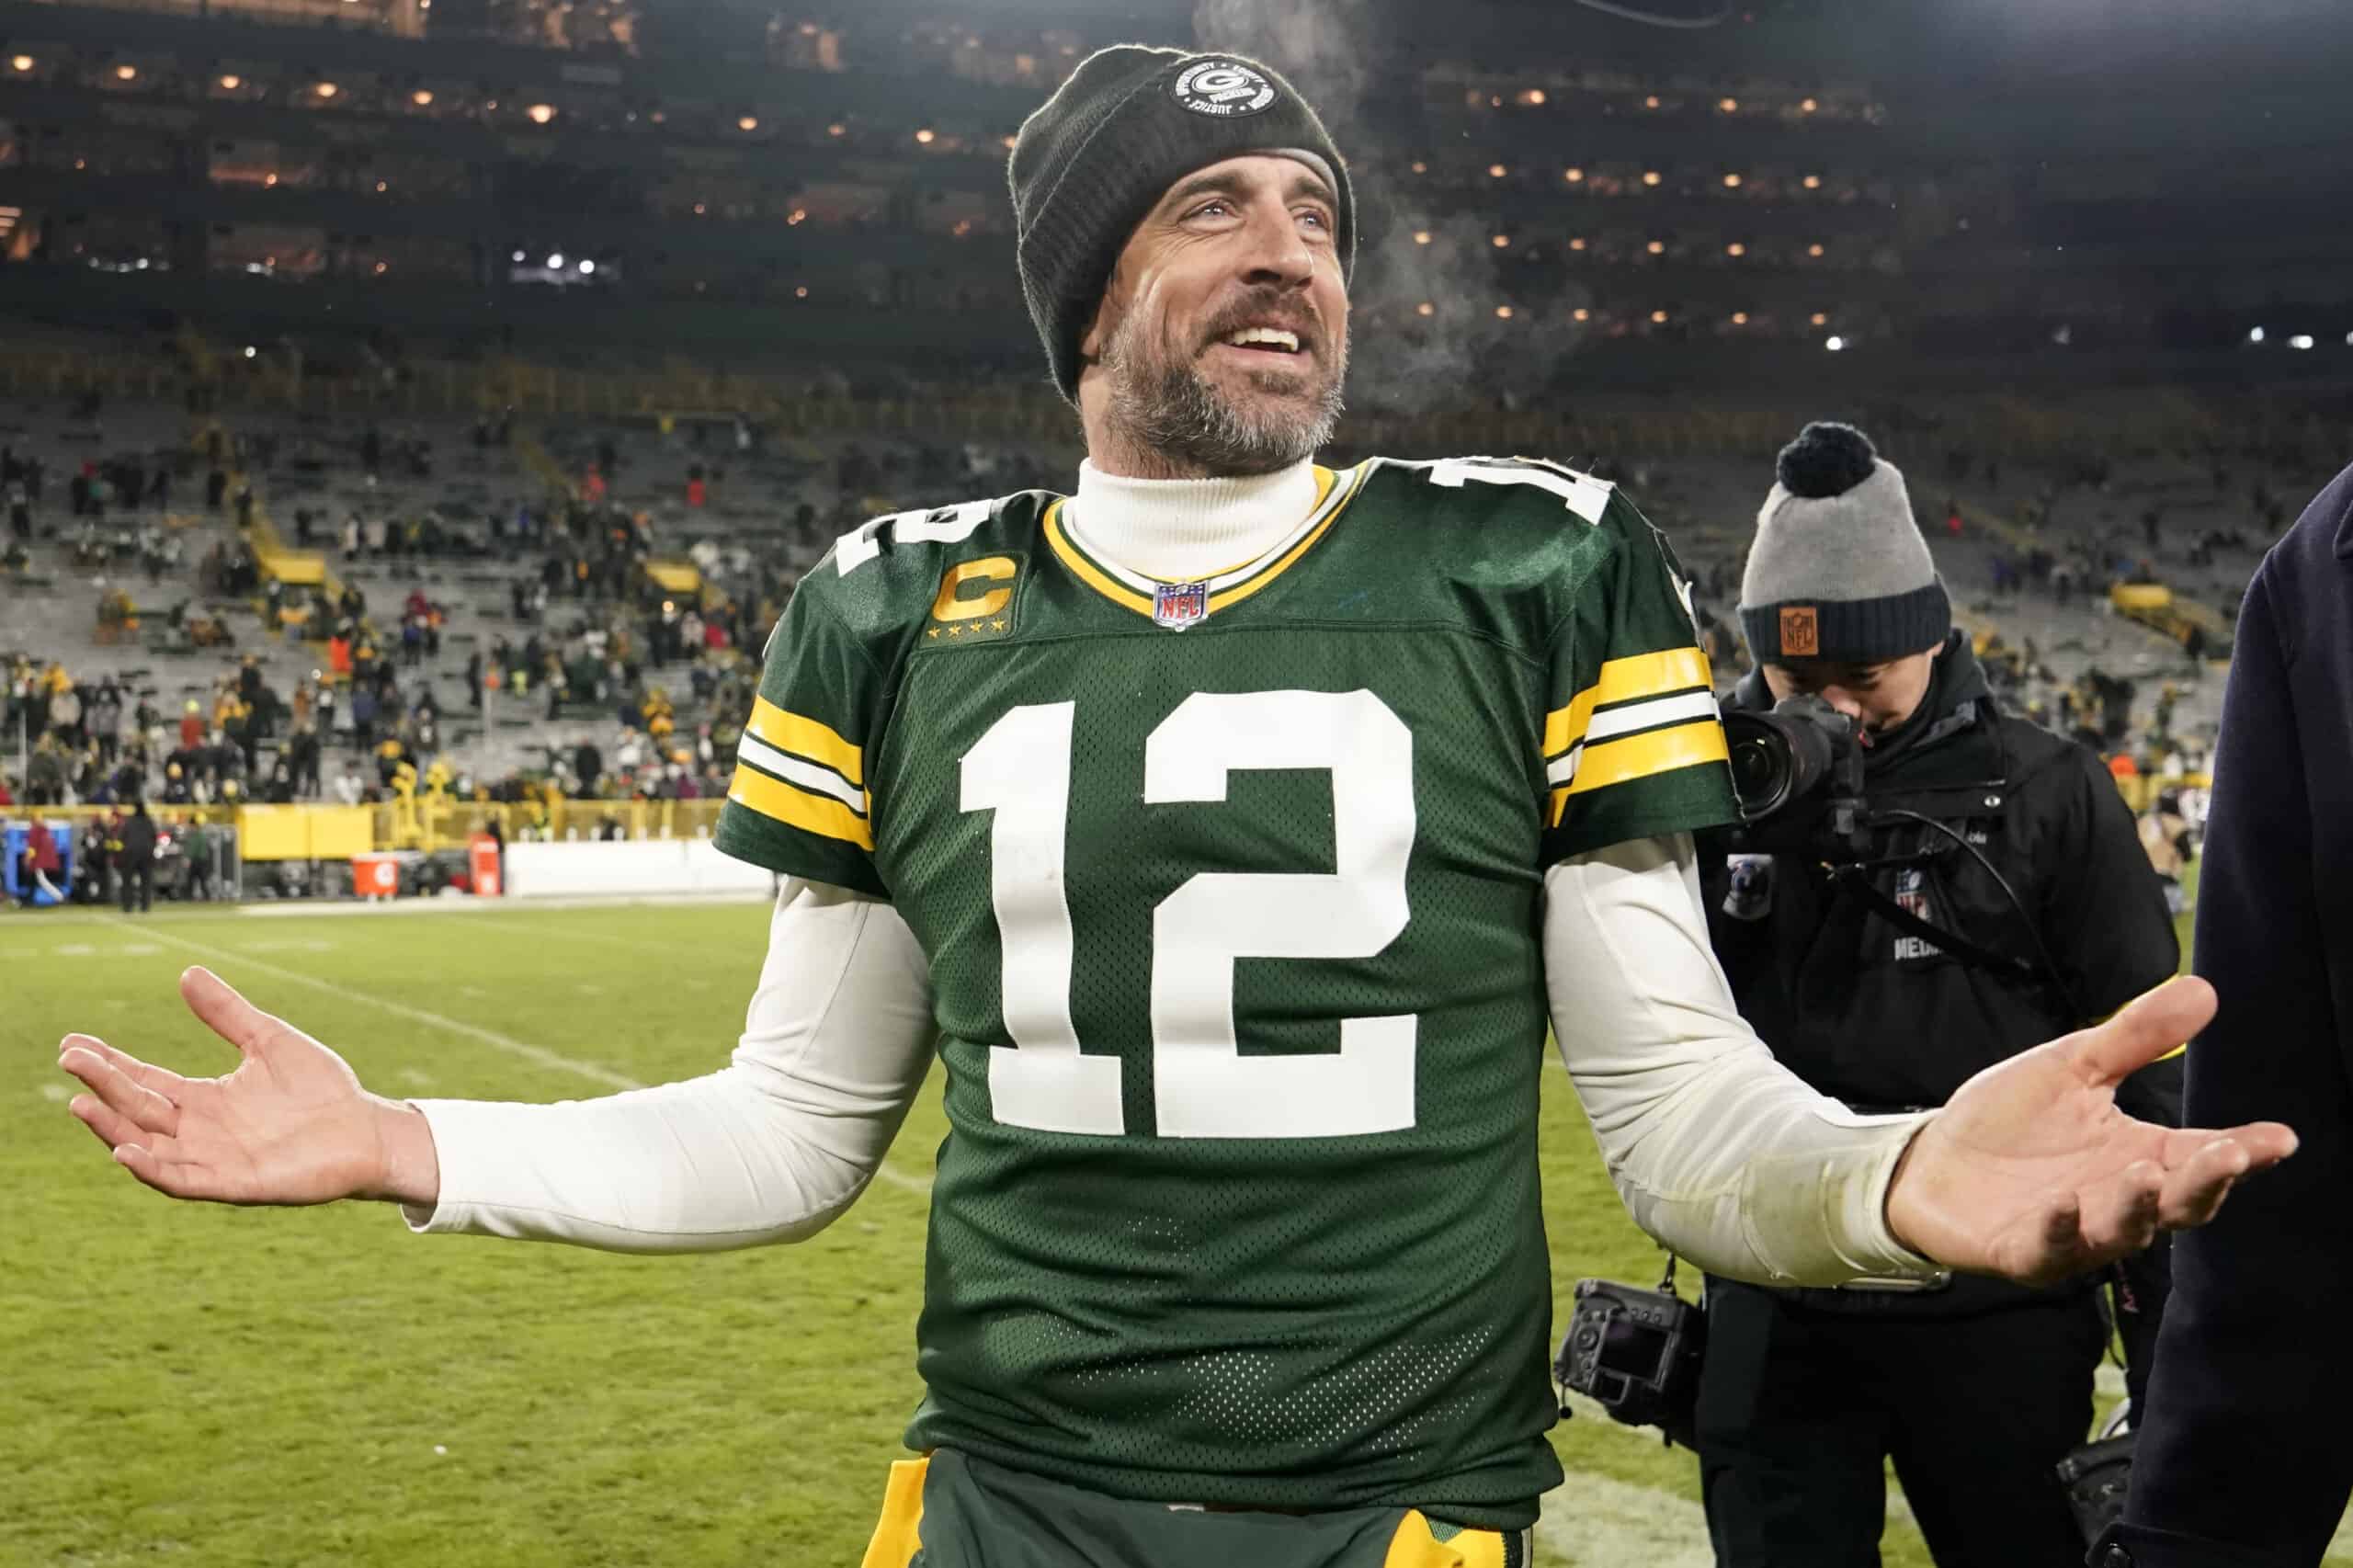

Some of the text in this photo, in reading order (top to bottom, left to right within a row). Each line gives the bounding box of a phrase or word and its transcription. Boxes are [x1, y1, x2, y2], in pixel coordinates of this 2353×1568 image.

[1193, 69, 1248, 93] G
[933, 556, 1017, 622] C
[1162, 596, 1199, 619] NFL
[960, 688, 1417, 1139] 12
